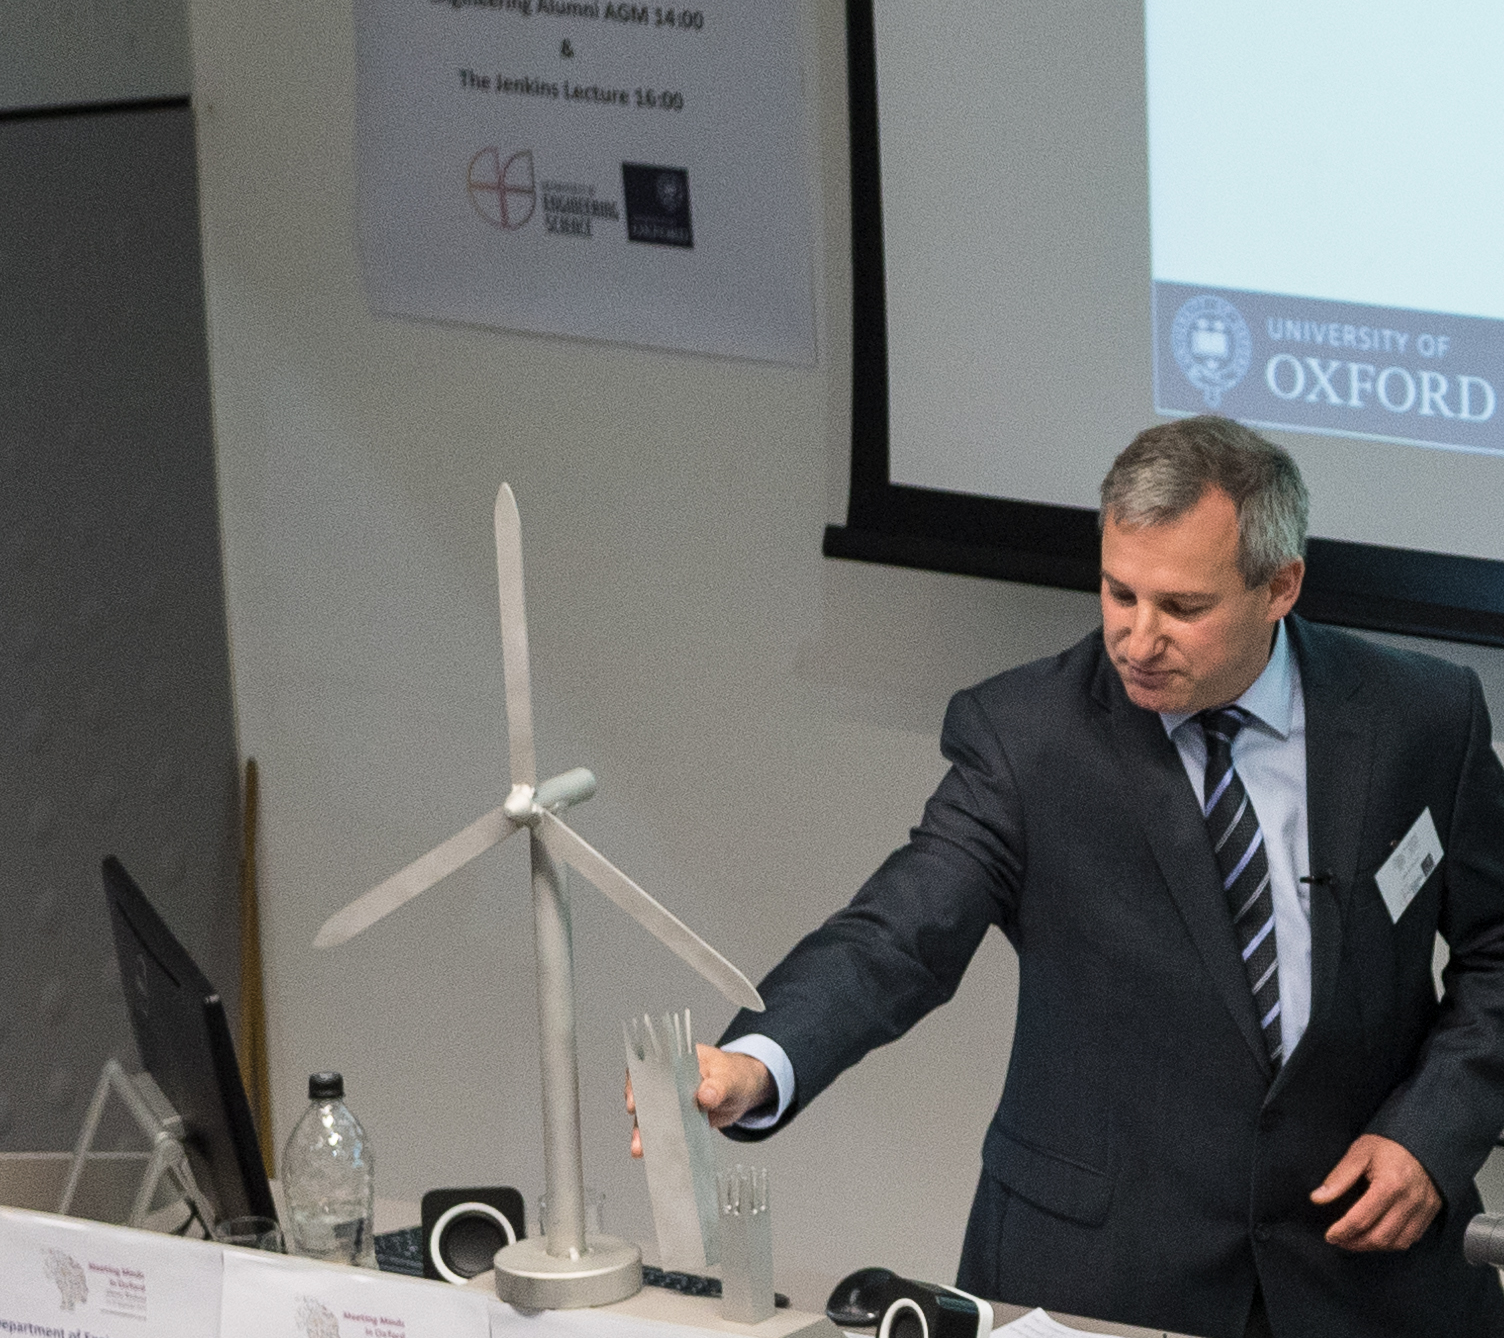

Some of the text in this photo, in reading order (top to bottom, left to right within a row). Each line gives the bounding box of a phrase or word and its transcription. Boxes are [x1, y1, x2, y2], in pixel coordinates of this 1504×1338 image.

[604, 1, 649, 24] AGM
[655, 7, 704, 30] 14:00
[560, 38, 574, 58] &
[459, 68, 491, 90] The
[495, 74, 559, 99] Jenkins
[564, 80, 629, 105] Lecture
[1266, 317, 1451, 358] UNIVERSITY OF
[1266, 354, 1497, 422] OXFORD
